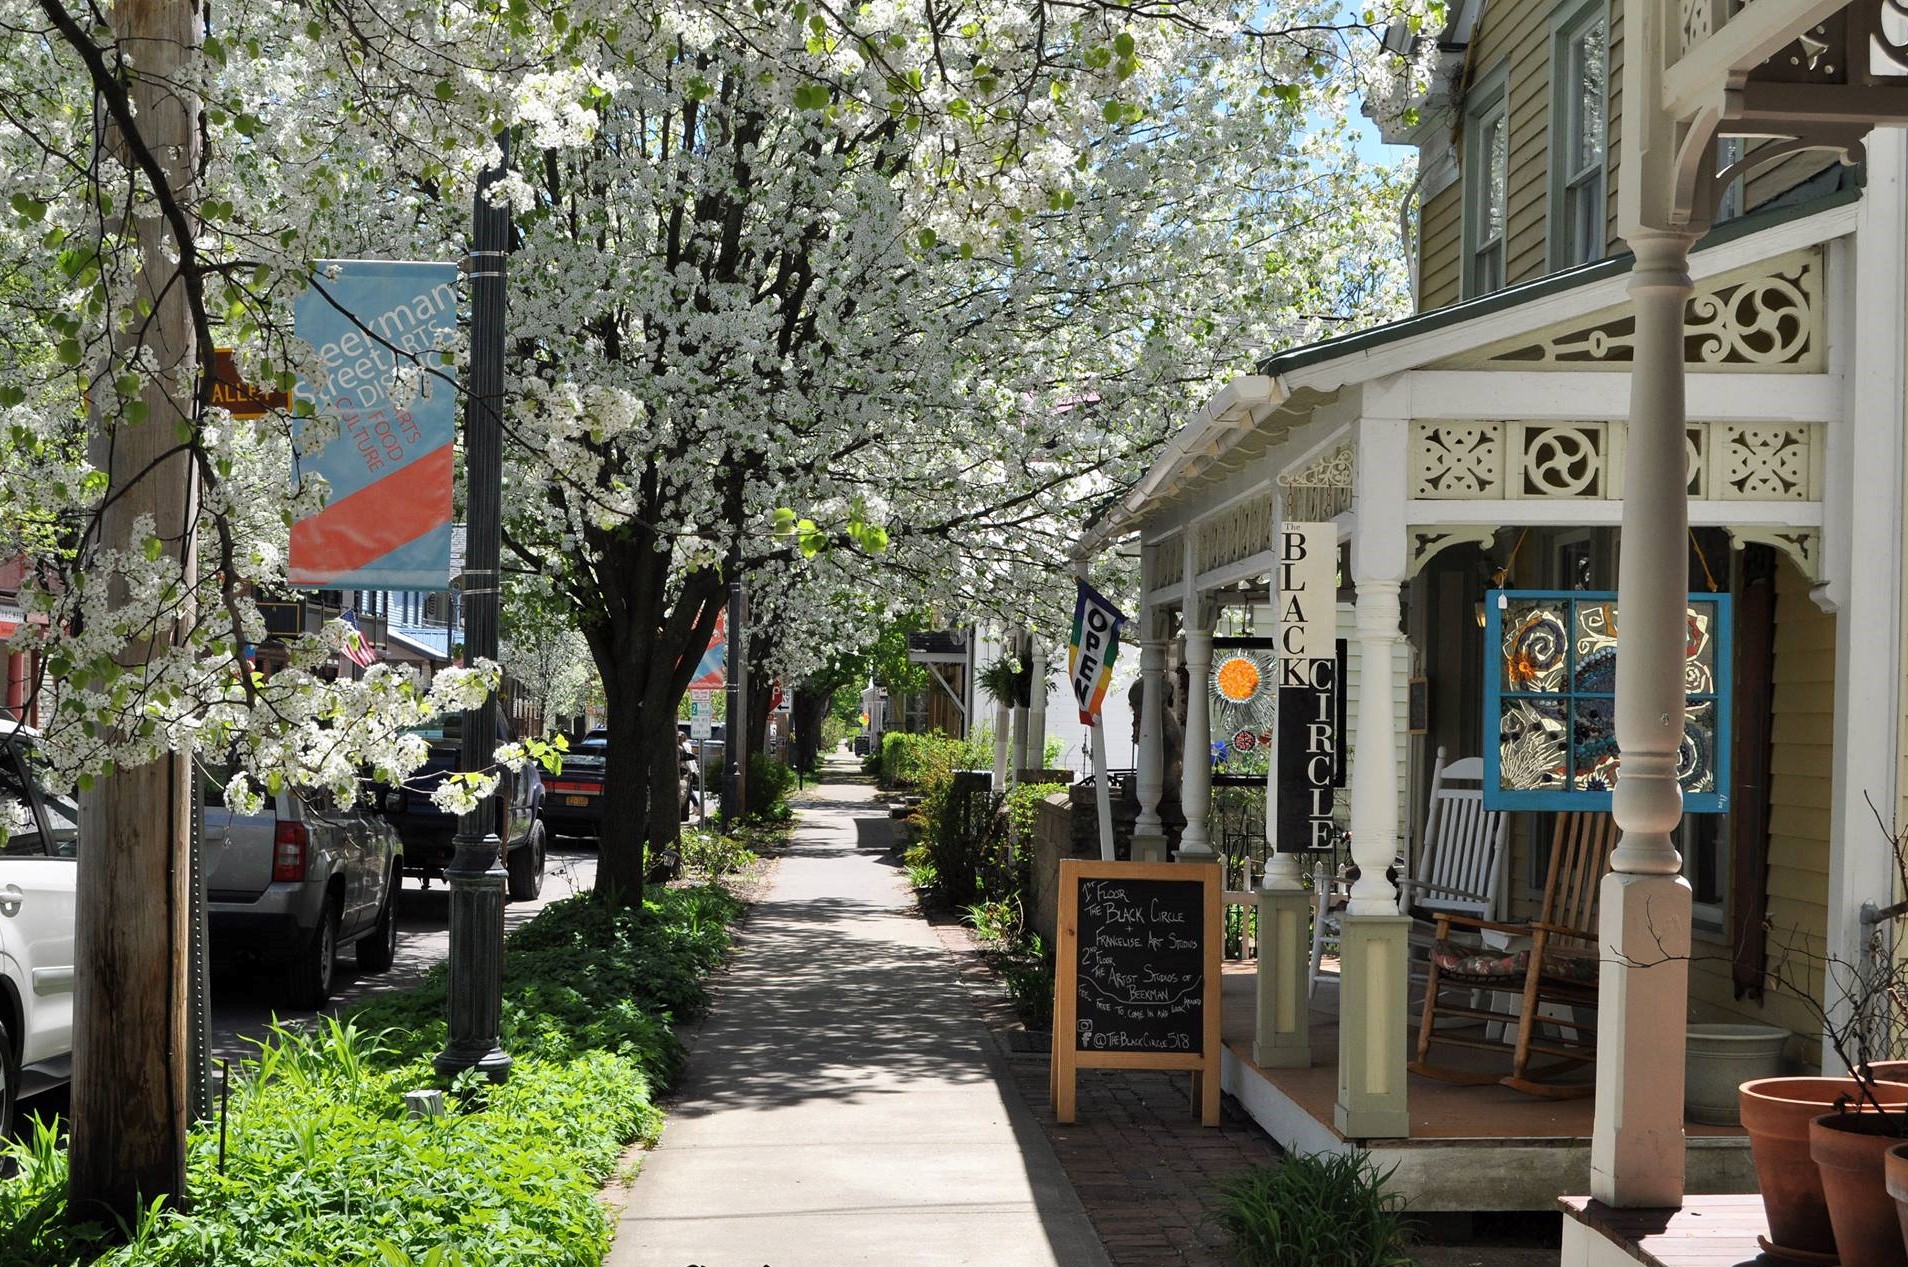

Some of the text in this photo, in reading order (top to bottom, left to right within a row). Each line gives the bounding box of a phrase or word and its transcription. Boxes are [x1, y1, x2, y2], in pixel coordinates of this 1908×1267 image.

[320, 283, 457, 368] eekman
[337, 397, 385, 473] CULTURE
[368, 409, 404, 461] FOOD
[1284, 522, 1301, 531] The
[1279, 532, 1308, 686] BLACK
[1075, 607, 1108, 706] OPEN
[1306, 660, 1334, 849] CIRCLE
[1103, 902, 1145, 924] BLACK
[1151, 898, 1185, 924] CIRCLE
